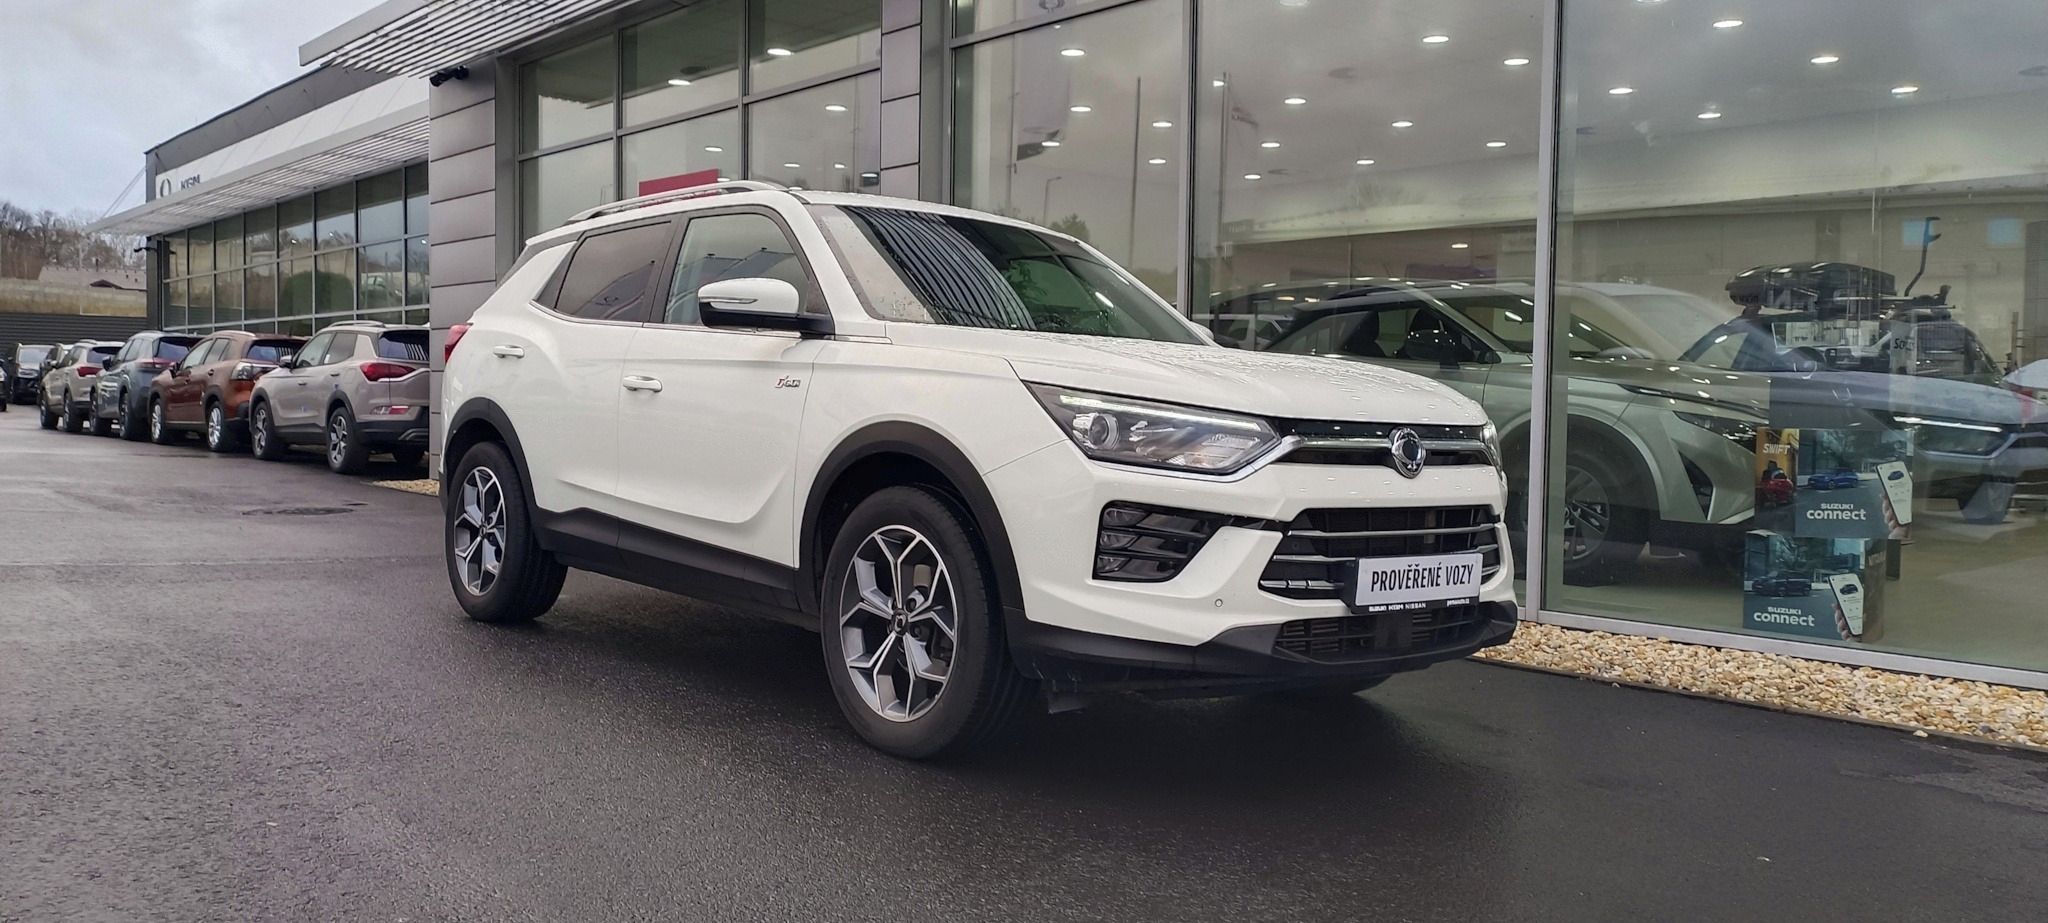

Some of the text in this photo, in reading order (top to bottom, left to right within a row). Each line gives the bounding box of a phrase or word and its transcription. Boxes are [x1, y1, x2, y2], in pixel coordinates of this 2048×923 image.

[1762, 443, 1791, 455] SWIFT
[1806, 509, 1867, 520] connect
[1370, 562, 1474, 592] PROVĚŘENÉ VOZY
[1405, 602, 1427, 610] NISSAN
[1767, 606, 1802, 615] SUZUKI
[1753, 612, 1815, 627] connect
